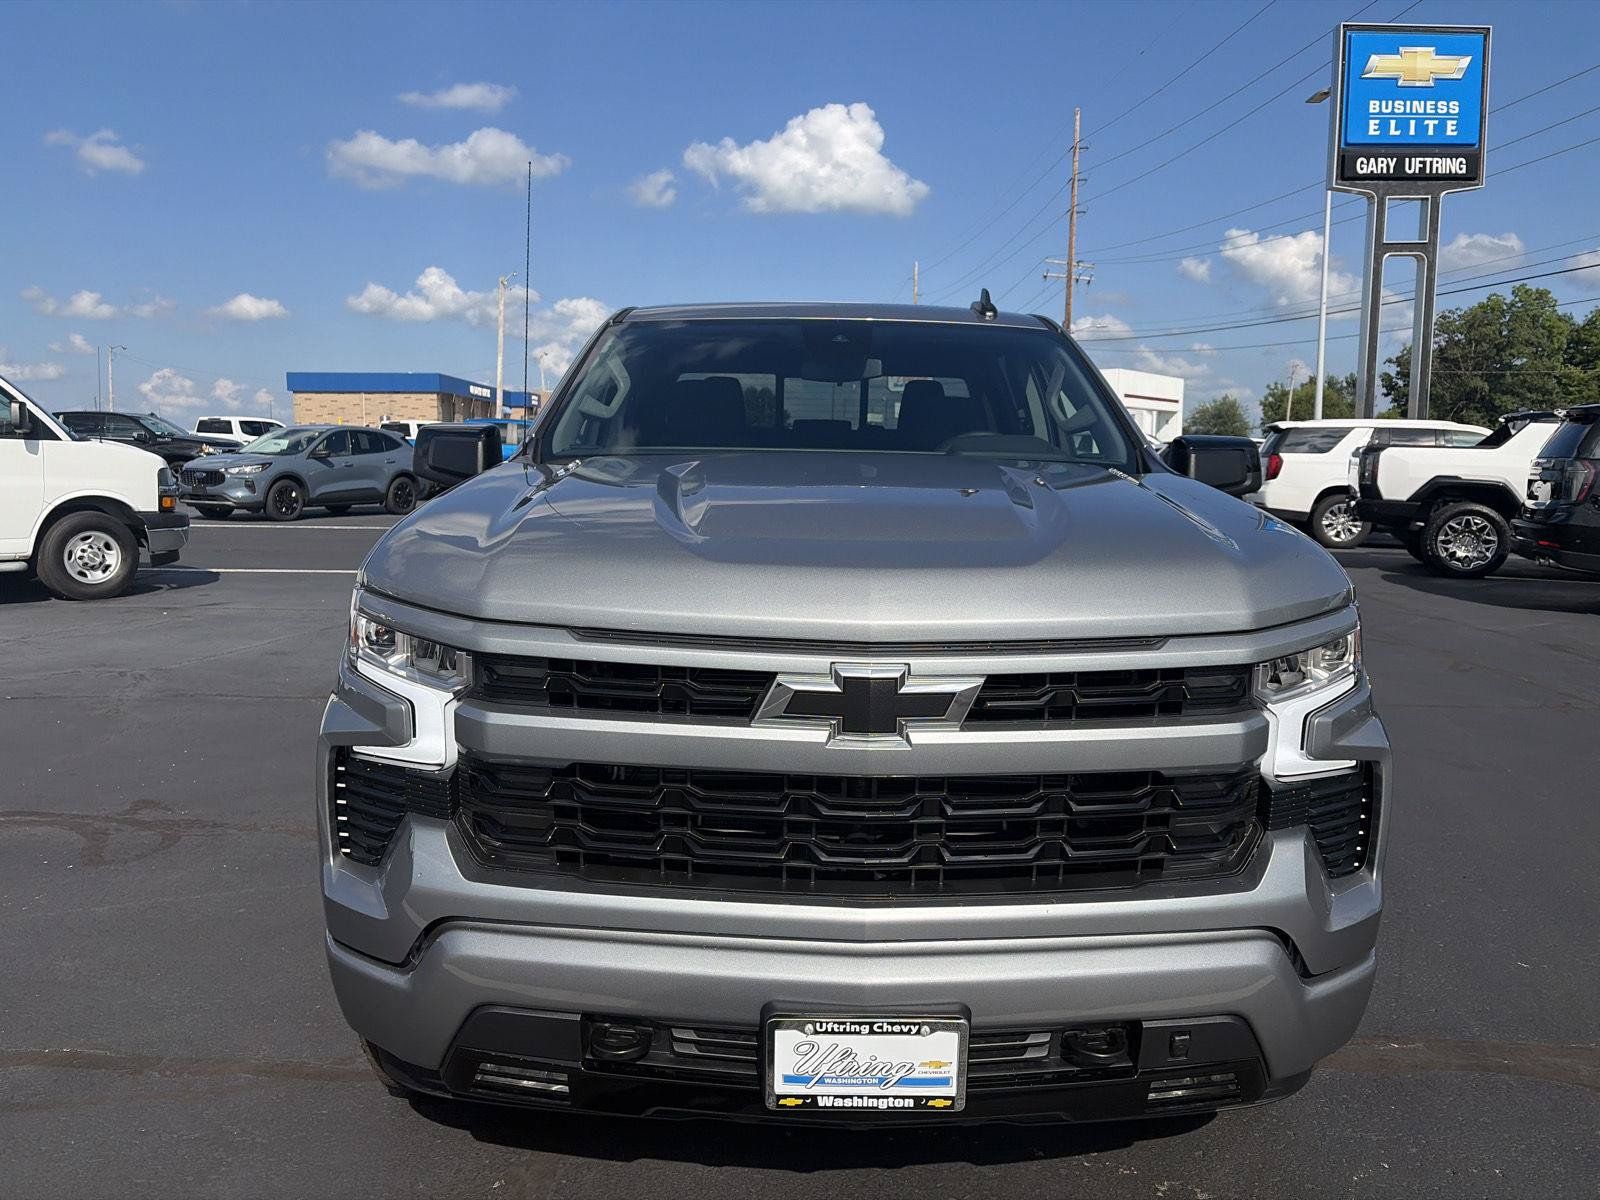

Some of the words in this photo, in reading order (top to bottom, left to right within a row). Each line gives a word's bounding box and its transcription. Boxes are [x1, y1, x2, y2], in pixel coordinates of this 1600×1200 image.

[1369, 100, 1460, 114] BUSINESS
[1368, 119, 1459, 136] ELITE
[1356, 157, 1397, 174] GARY
[1404, 157, 1467, 175] UFTRING
[815, 1022, 870, 1035] Uftring
[873, 1022, 919, 1035] Chevy
[792, 1040, 916, 1090] Uftring
[817, 1096, 915, 1109] Washington
